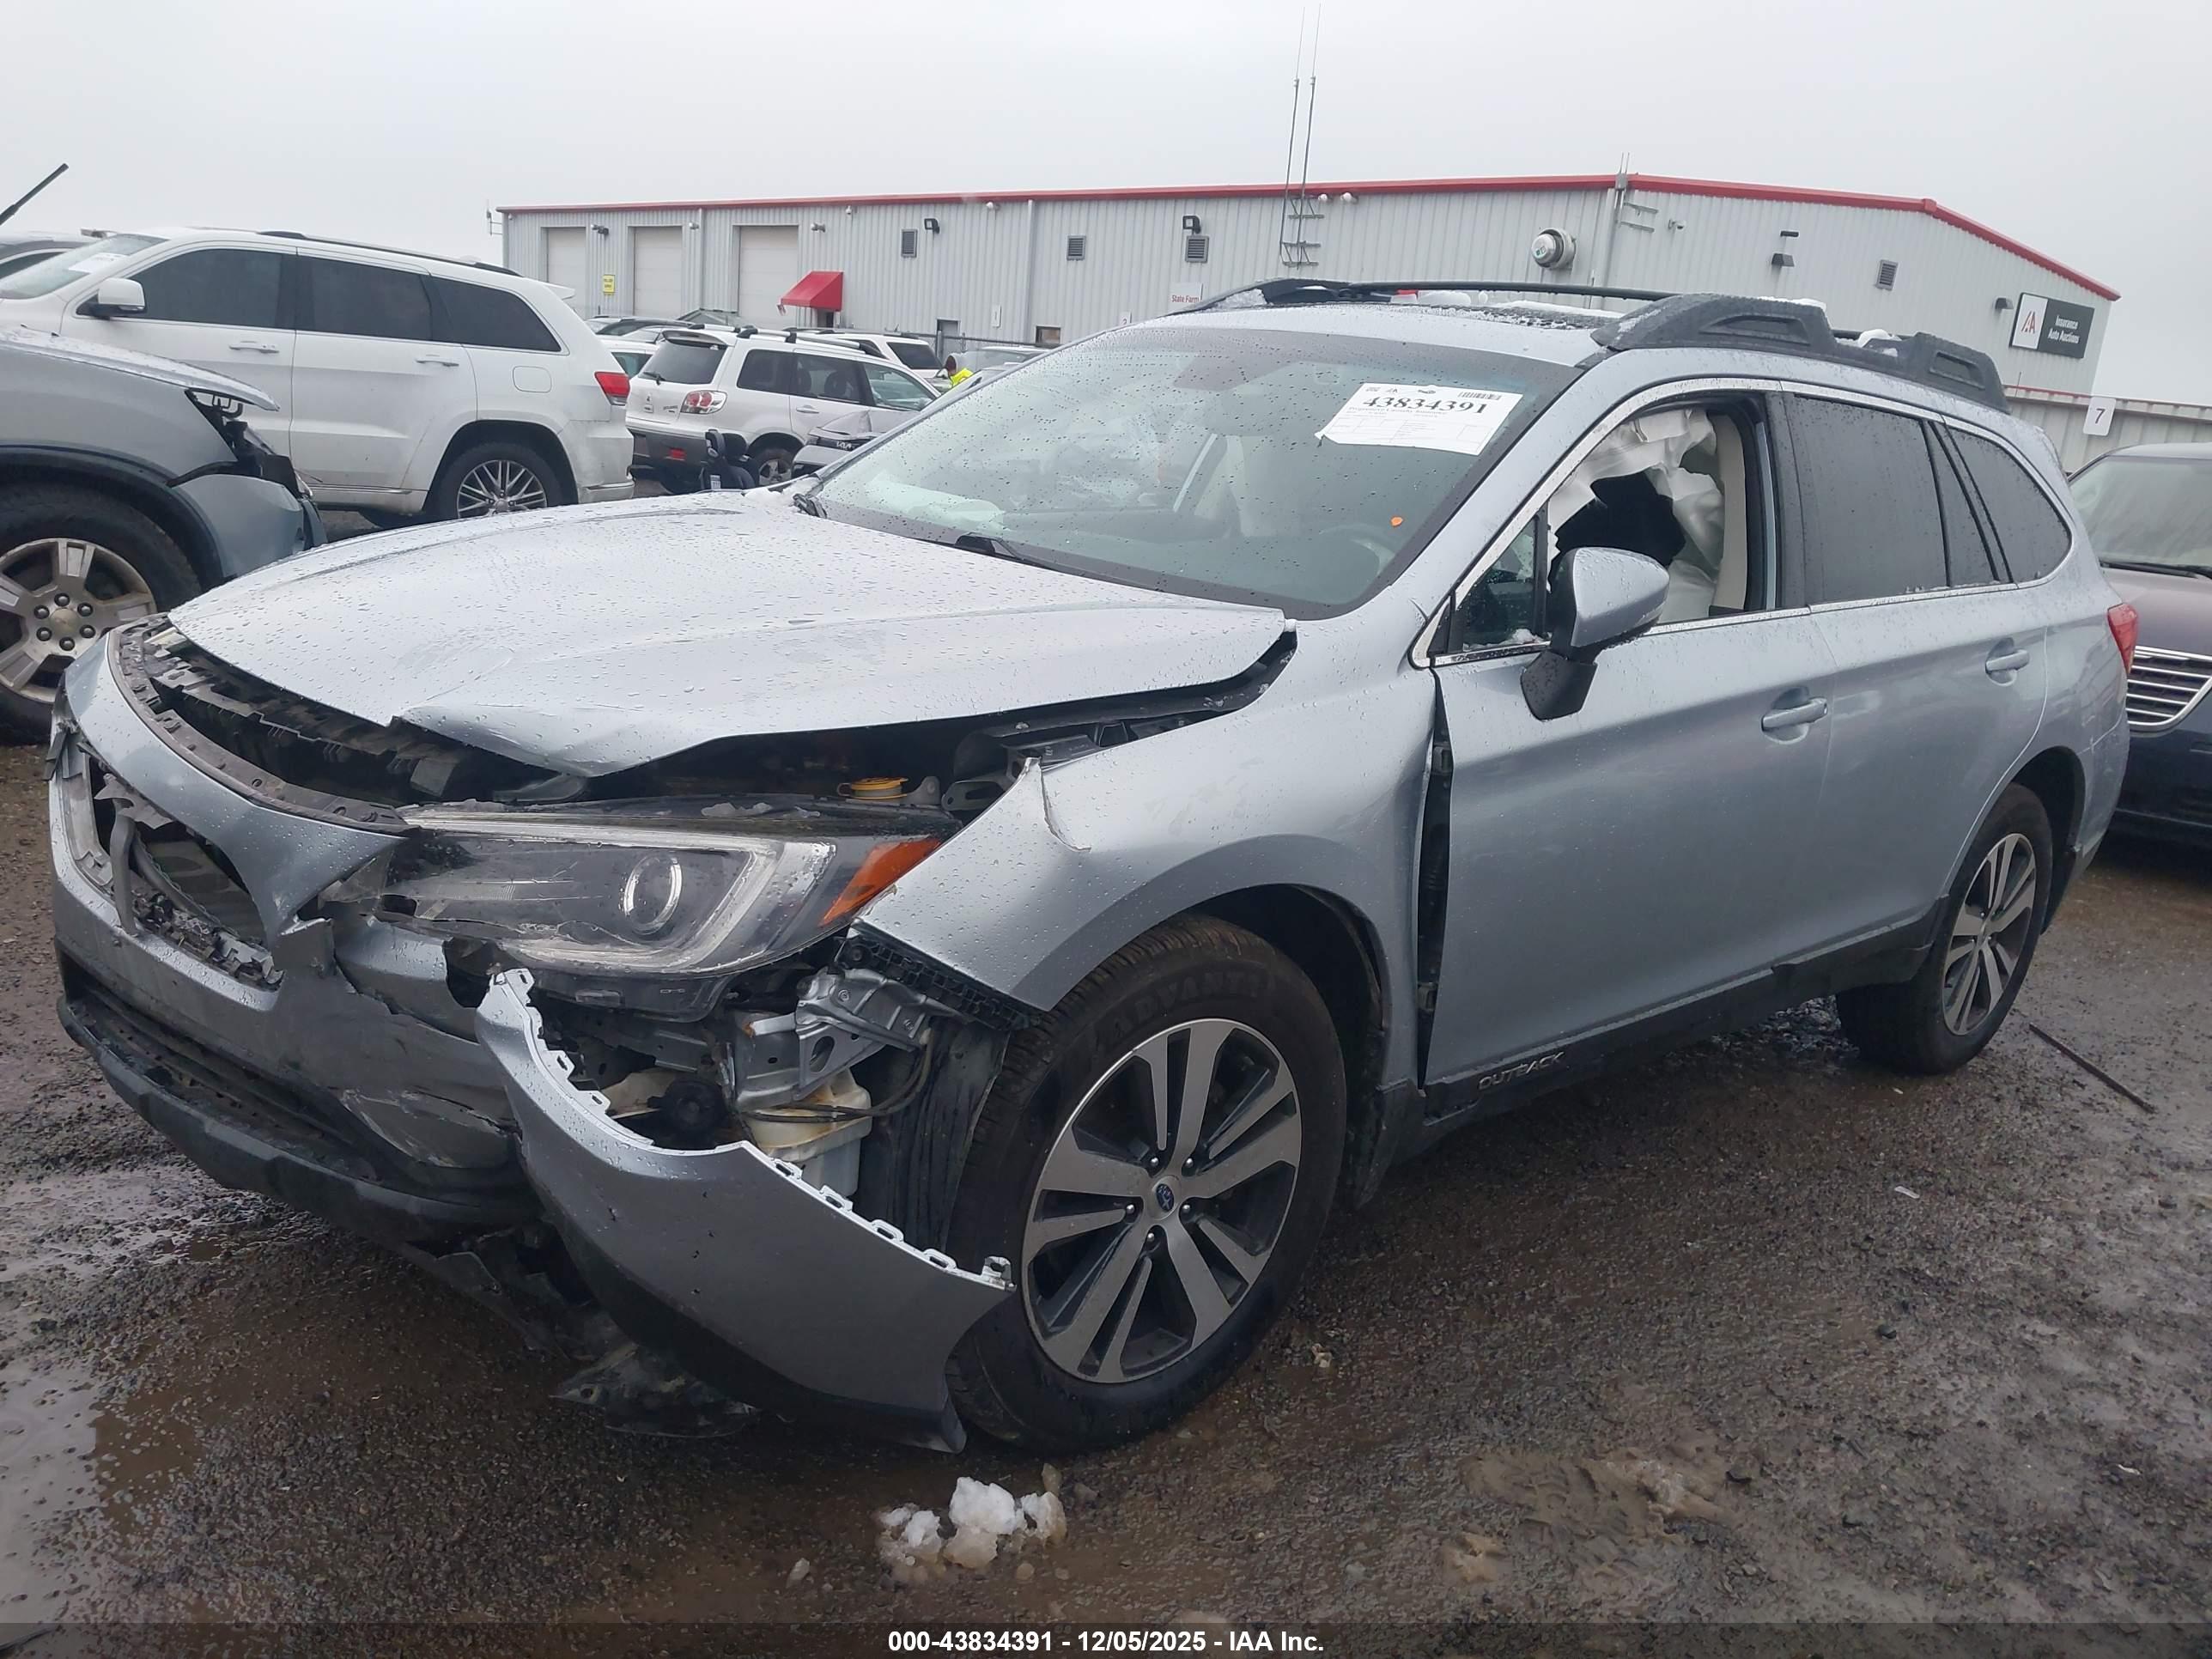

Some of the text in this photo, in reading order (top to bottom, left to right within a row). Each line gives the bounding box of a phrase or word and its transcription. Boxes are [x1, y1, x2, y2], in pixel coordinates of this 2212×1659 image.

[2055, 314, 2079, 331] Insurance
[2047, 328, 2081, 344] Auto Auctions
[1363, 396, 1488, 414] 43834391
[2094, 408, 2106, 424] 7
